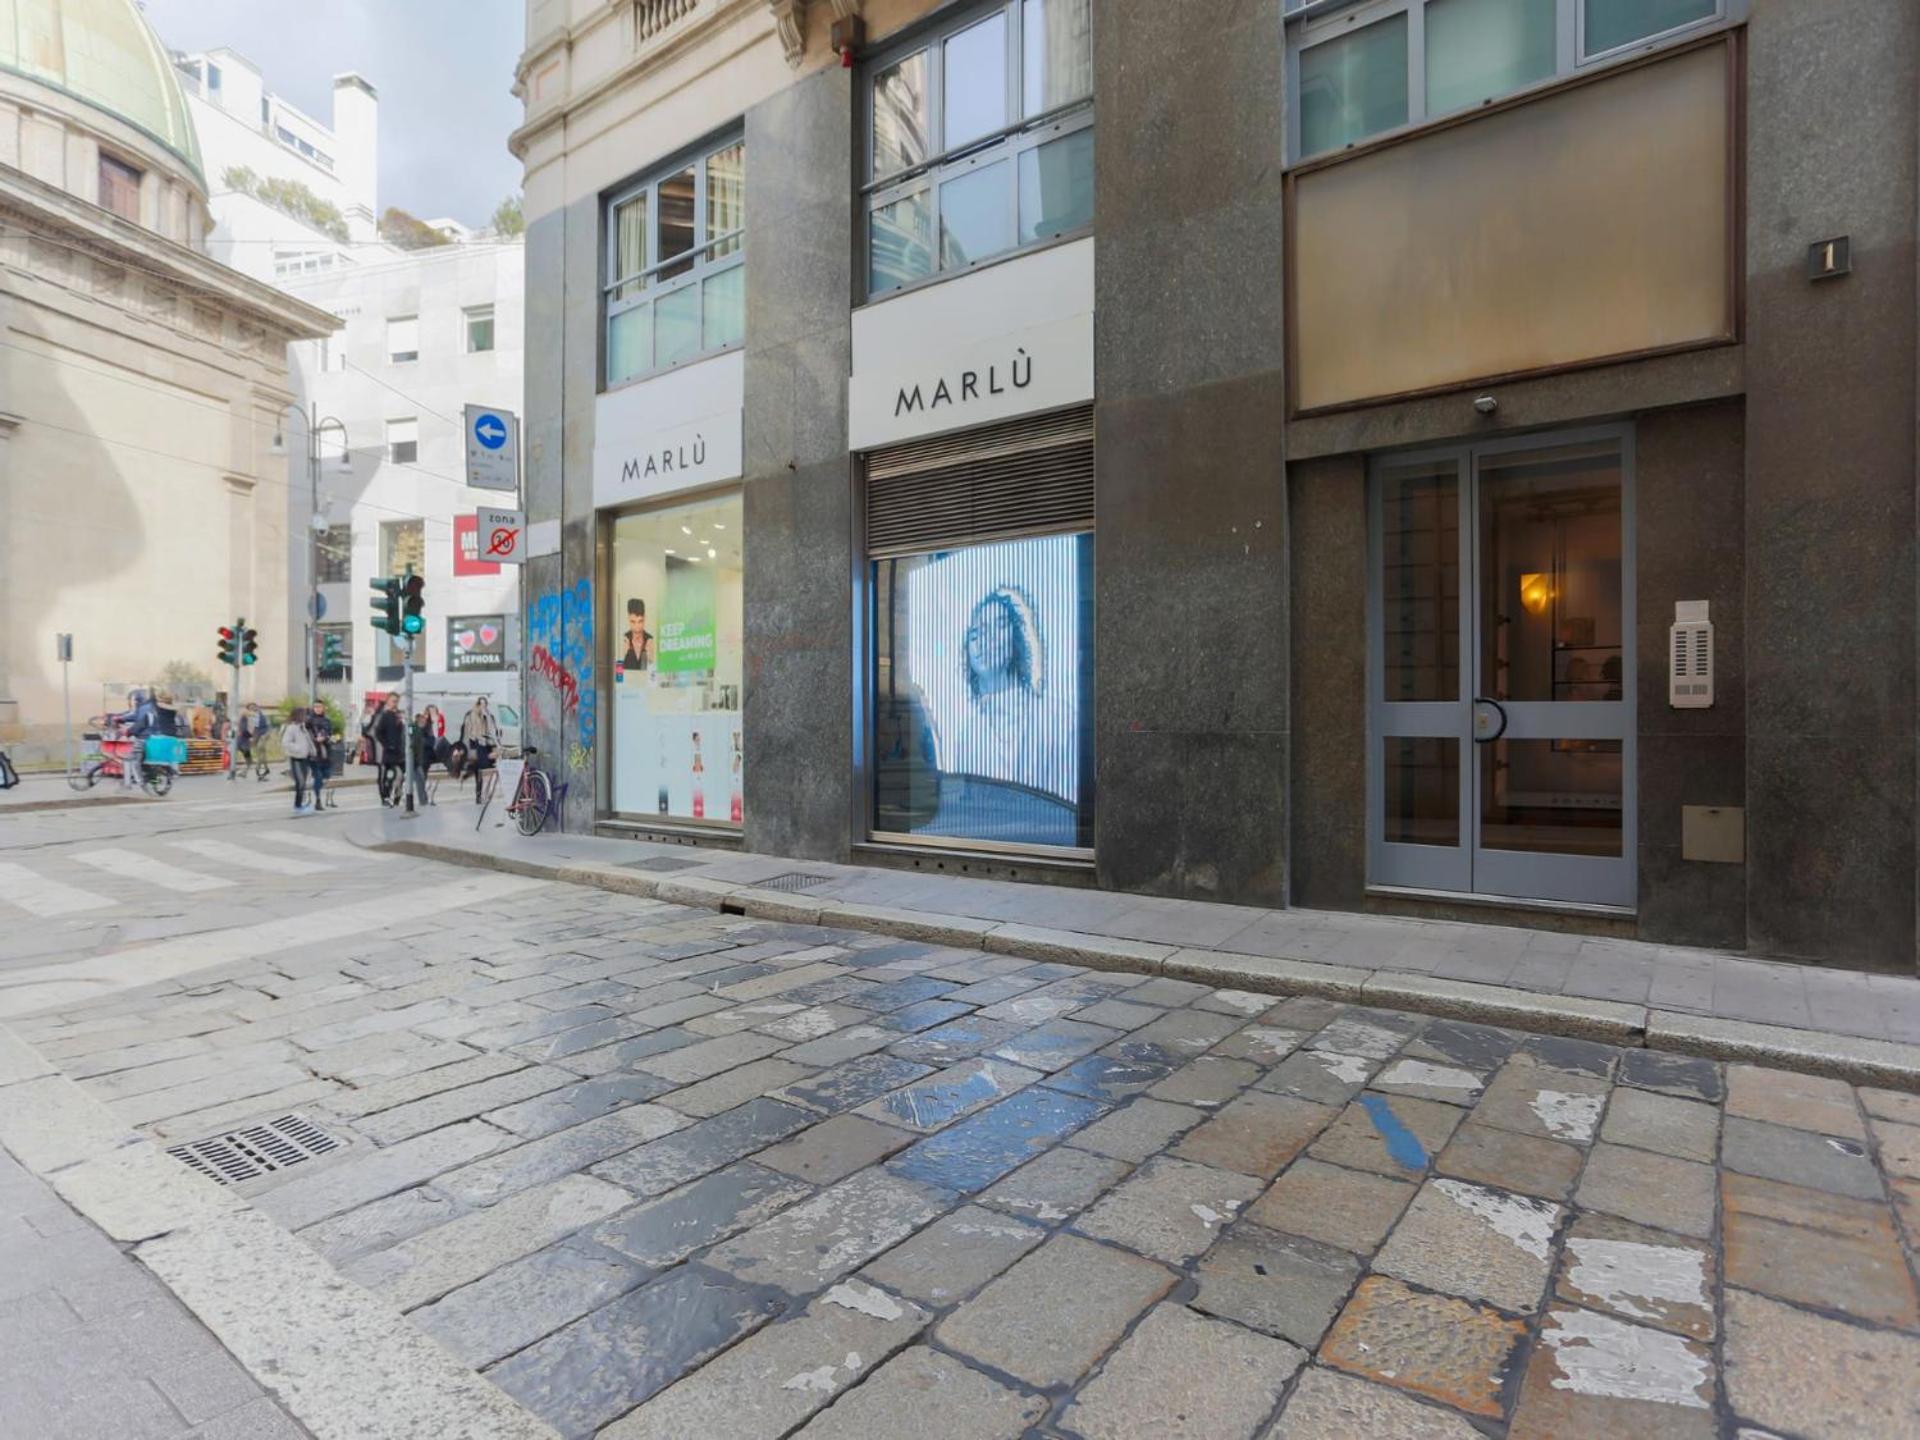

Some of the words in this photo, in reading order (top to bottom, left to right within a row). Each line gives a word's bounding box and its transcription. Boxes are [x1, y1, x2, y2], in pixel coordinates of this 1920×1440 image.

[1823, 243, 1835, 271] 1
[894, 347, 1031, 417] MARLÙ
[621, 433, 706, 483] MARLÙ
[488, 514, 515, 524] zona
[659, 633, 713, 652] DREAMING
[460, 653, 500, 665] SEPHORA
